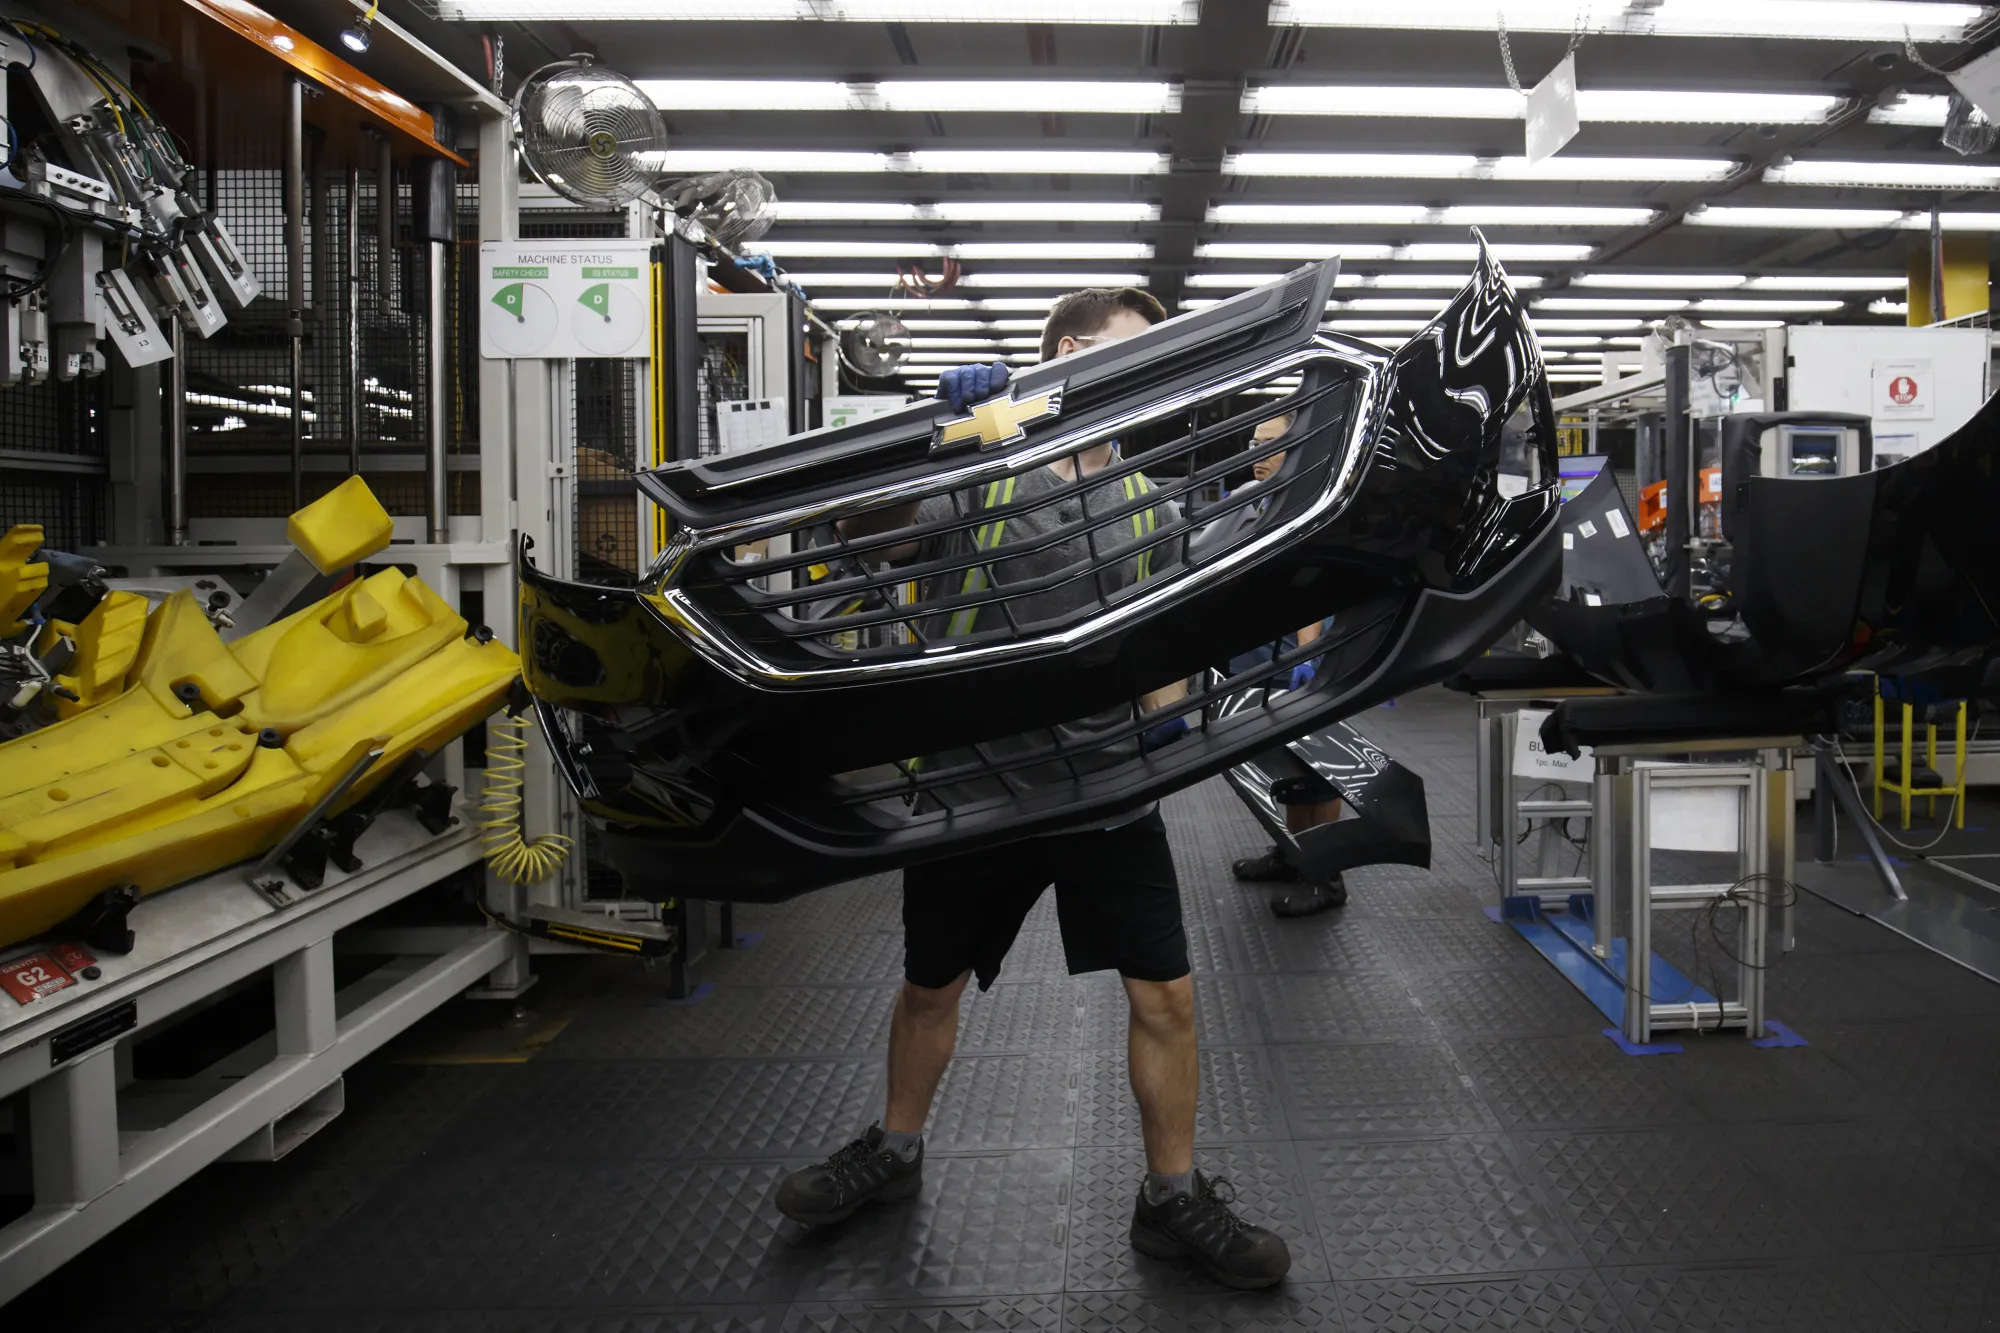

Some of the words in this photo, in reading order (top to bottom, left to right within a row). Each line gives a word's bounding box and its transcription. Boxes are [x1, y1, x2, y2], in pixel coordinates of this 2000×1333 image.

[518, 255, 567, 264] MACHINE
[570, 255, 613, 264] STATUS
[493, 269, 519, 277] SAFETY
[520, 269, 548, 277] CHECKS
[507, 295, 516, 304] D
[594, 295, 603, 304] D
[138, 339, 150, 348] 13
[16, 966, 52, 986] G2
